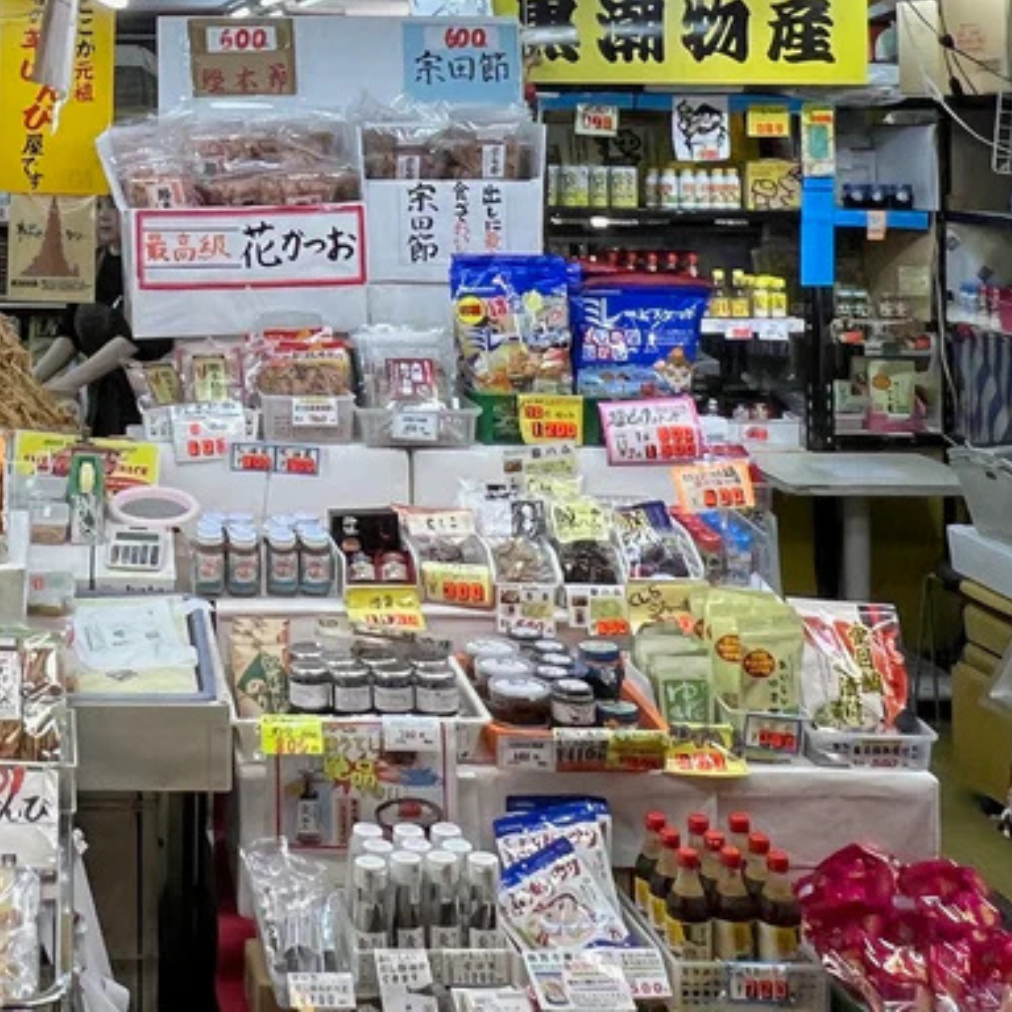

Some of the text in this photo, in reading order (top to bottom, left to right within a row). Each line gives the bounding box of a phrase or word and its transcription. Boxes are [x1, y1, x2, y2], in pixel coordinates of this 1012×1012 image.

[444, 28, 486, 48] 600
[415, 51, 510, 84] 宗田節
[407, 183, 439, 263] 宗田節
[146, 220, 357, 270] 最高級 花がつお
